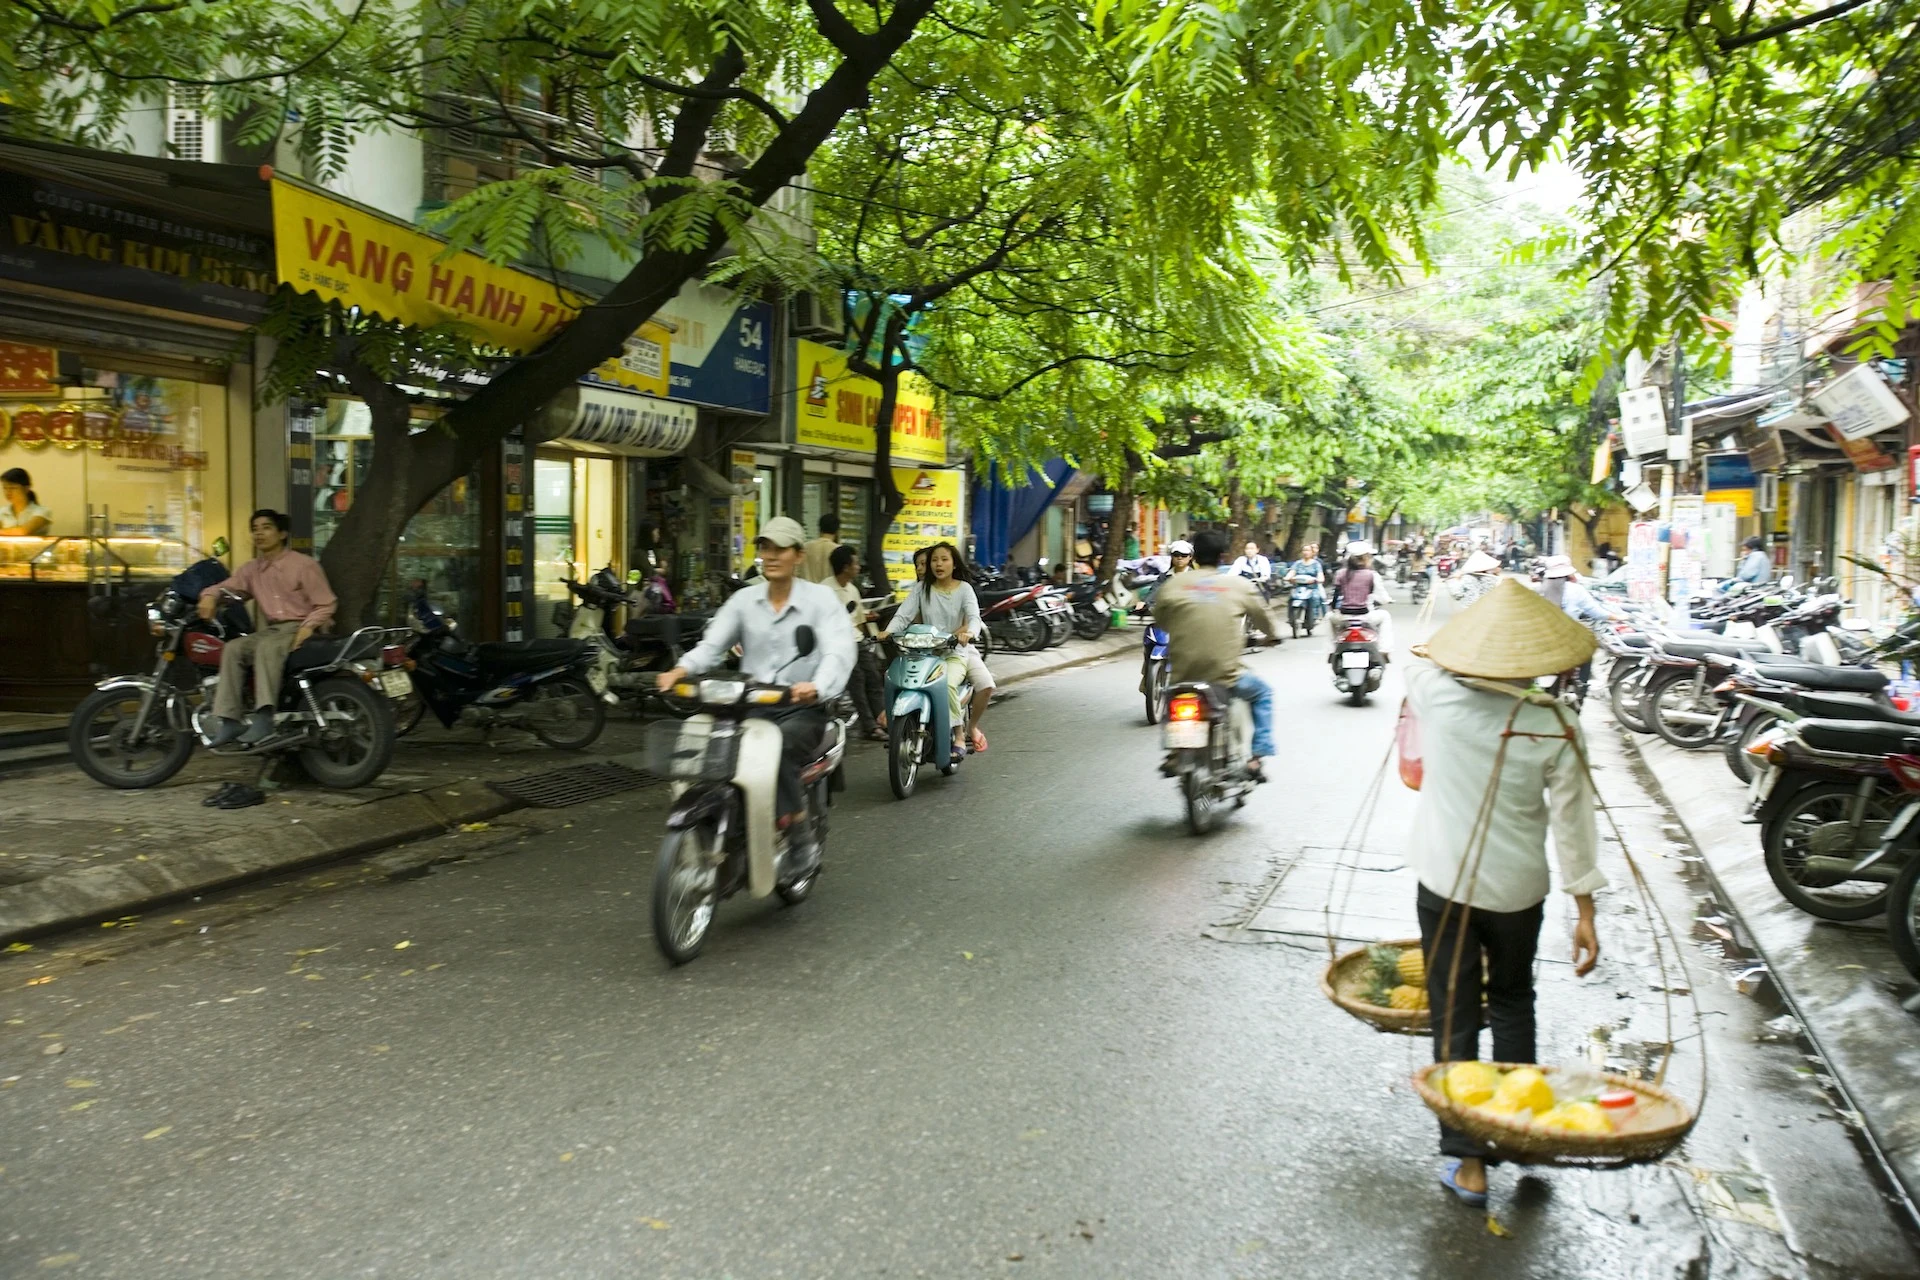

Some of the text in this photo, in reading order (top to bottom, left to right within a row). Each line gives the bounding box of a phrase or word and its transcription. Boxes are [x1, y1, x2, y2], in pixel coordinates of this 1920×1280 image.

[10, 209, 114, 263] VÀNG
[121, 239, 192, 278] KIM
[303, 216, 579, 335] VÀNG HẠNH TH
[738, 317, 763, 351] 54
[902, 497, 952, 508] ourist
